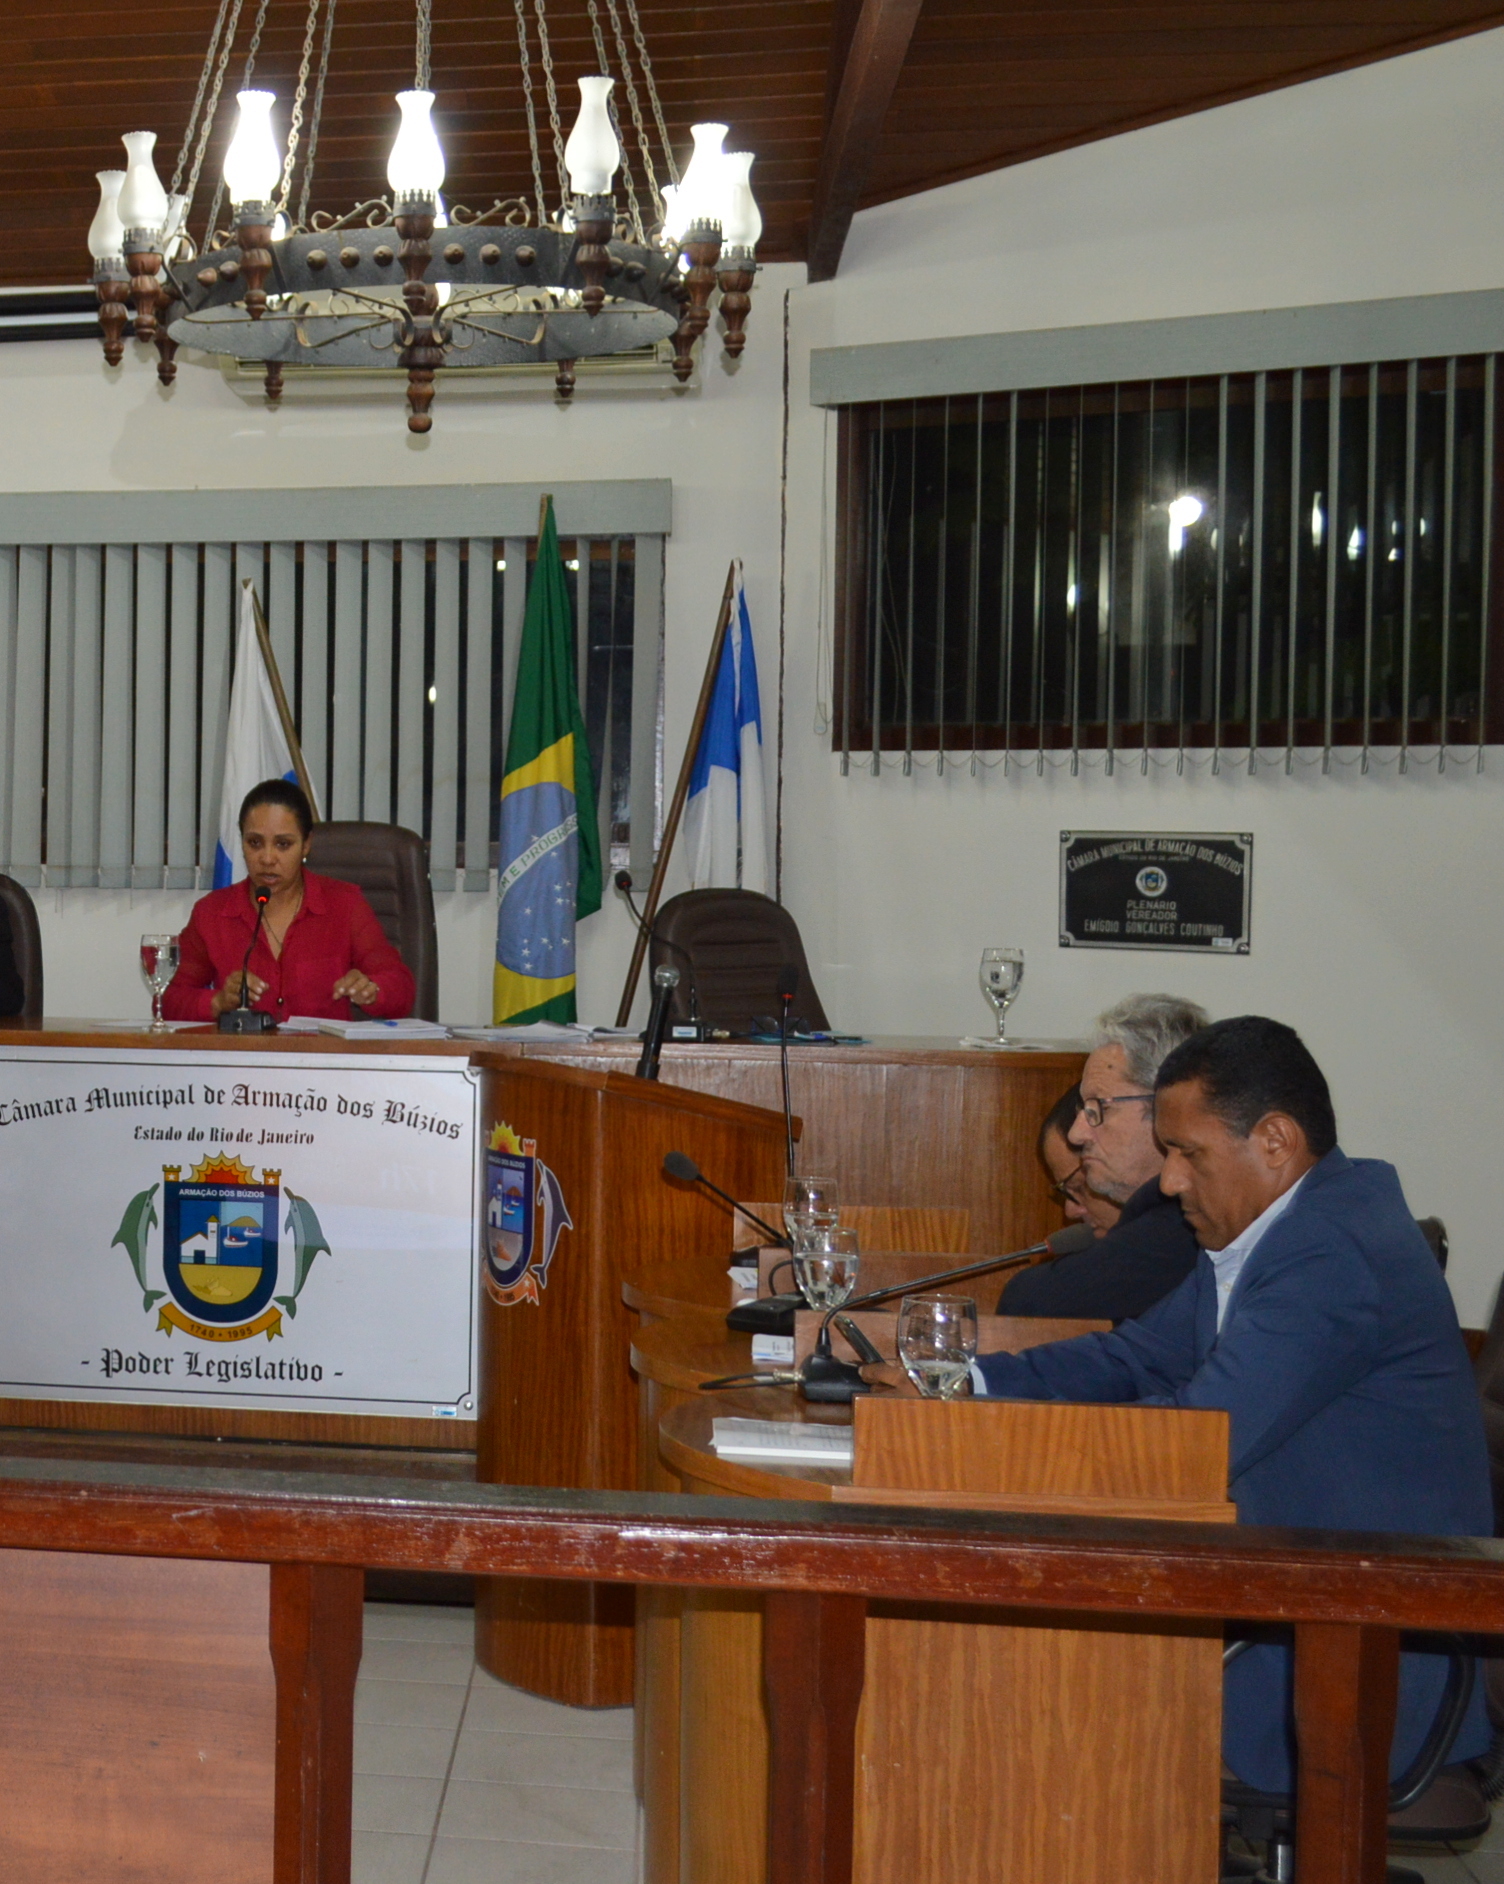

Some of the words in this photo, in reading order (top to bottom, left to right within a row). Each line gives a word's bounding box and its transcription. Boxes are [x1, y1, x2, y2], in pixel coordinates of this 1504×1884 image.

[1100, 840, 1143, 859] MUNICIPAL
[1145, 839, 1155, 852] DE
[1157, 840, 1196, 857] ARMAÇÃO
[1196, 846, 1215, 862] DOS
[1213, 852, 1243, 876] BÚZIOS
[1126, 899, 1177, 910] PLENÁRIO
[1126, 910, 1178, 920] VEREADOR
[1125, 921, 1175, 936] GONÇALVES
[1180, 923, 1224, 937] COUTINHO
[84, 1083, 195, 1113] Municipal
[203, 1084, 227, 1105] de
[231, 1083, 328, 1117] Armação
[336, 1094, 375, 1119] dos
[381, 1099, 464, 1140] Búzios
[133, 1125, 182, 1141] Estado
[186, 1126, 205, 1142] do
[209, 1127, 233, 1143] Rio
[235, 1128, 253, 1143] de
[257, 1128, 315, 1145] Janeiro
[178, 1188, 218, 1197] ARMAÇÃO
[236, 1189, 265, 1198] BÚZIOS
[190, 1324, 215, 1338] 1740
[227, 1326, 253, 1338] 1995
[100, 1348, 175, 1378] Poder
[183, 1351, 323, 1383] Legislativo
